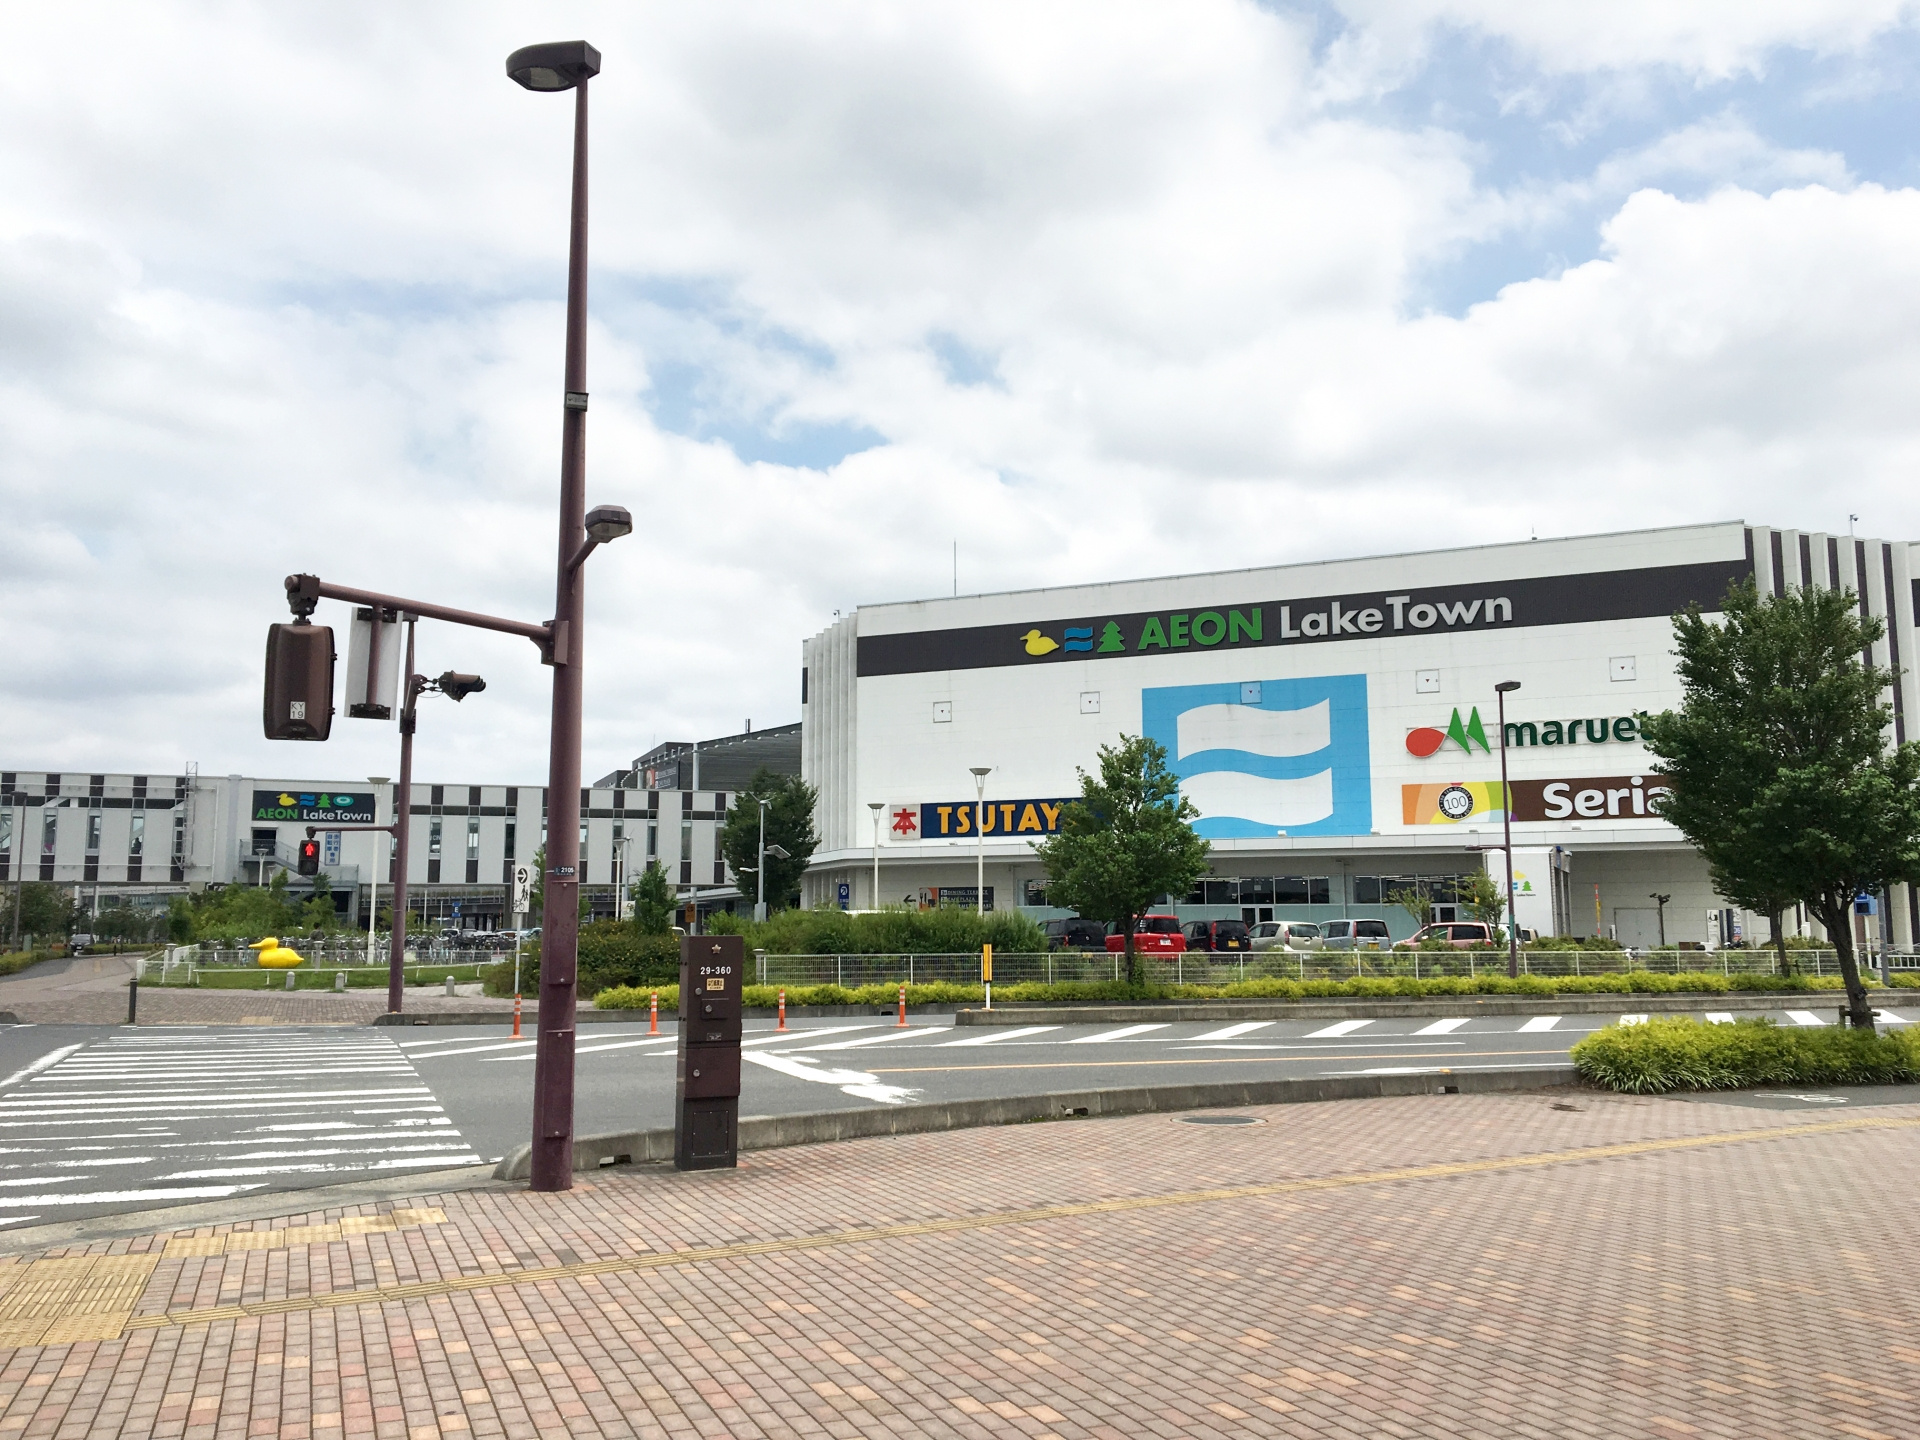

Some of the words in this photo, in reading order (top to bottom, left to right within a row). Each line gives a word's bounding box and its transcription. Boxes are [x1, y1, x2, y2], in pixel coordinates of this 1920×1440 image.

[1137, 608, 1263, 650] AEON
[1280, 595, 1513, 639] LakeTown
[291, 702, 305, 710] KY
[1444, 795, 1467, 810] 100
[256, 808, 299, 819] AEON
[303, 809, 372, 820] LakeTown
[892, 808, 917, 835] 本
[937, 802, 1067, 834] TSUTAY
[700, 966, 732, 975] 29-360
